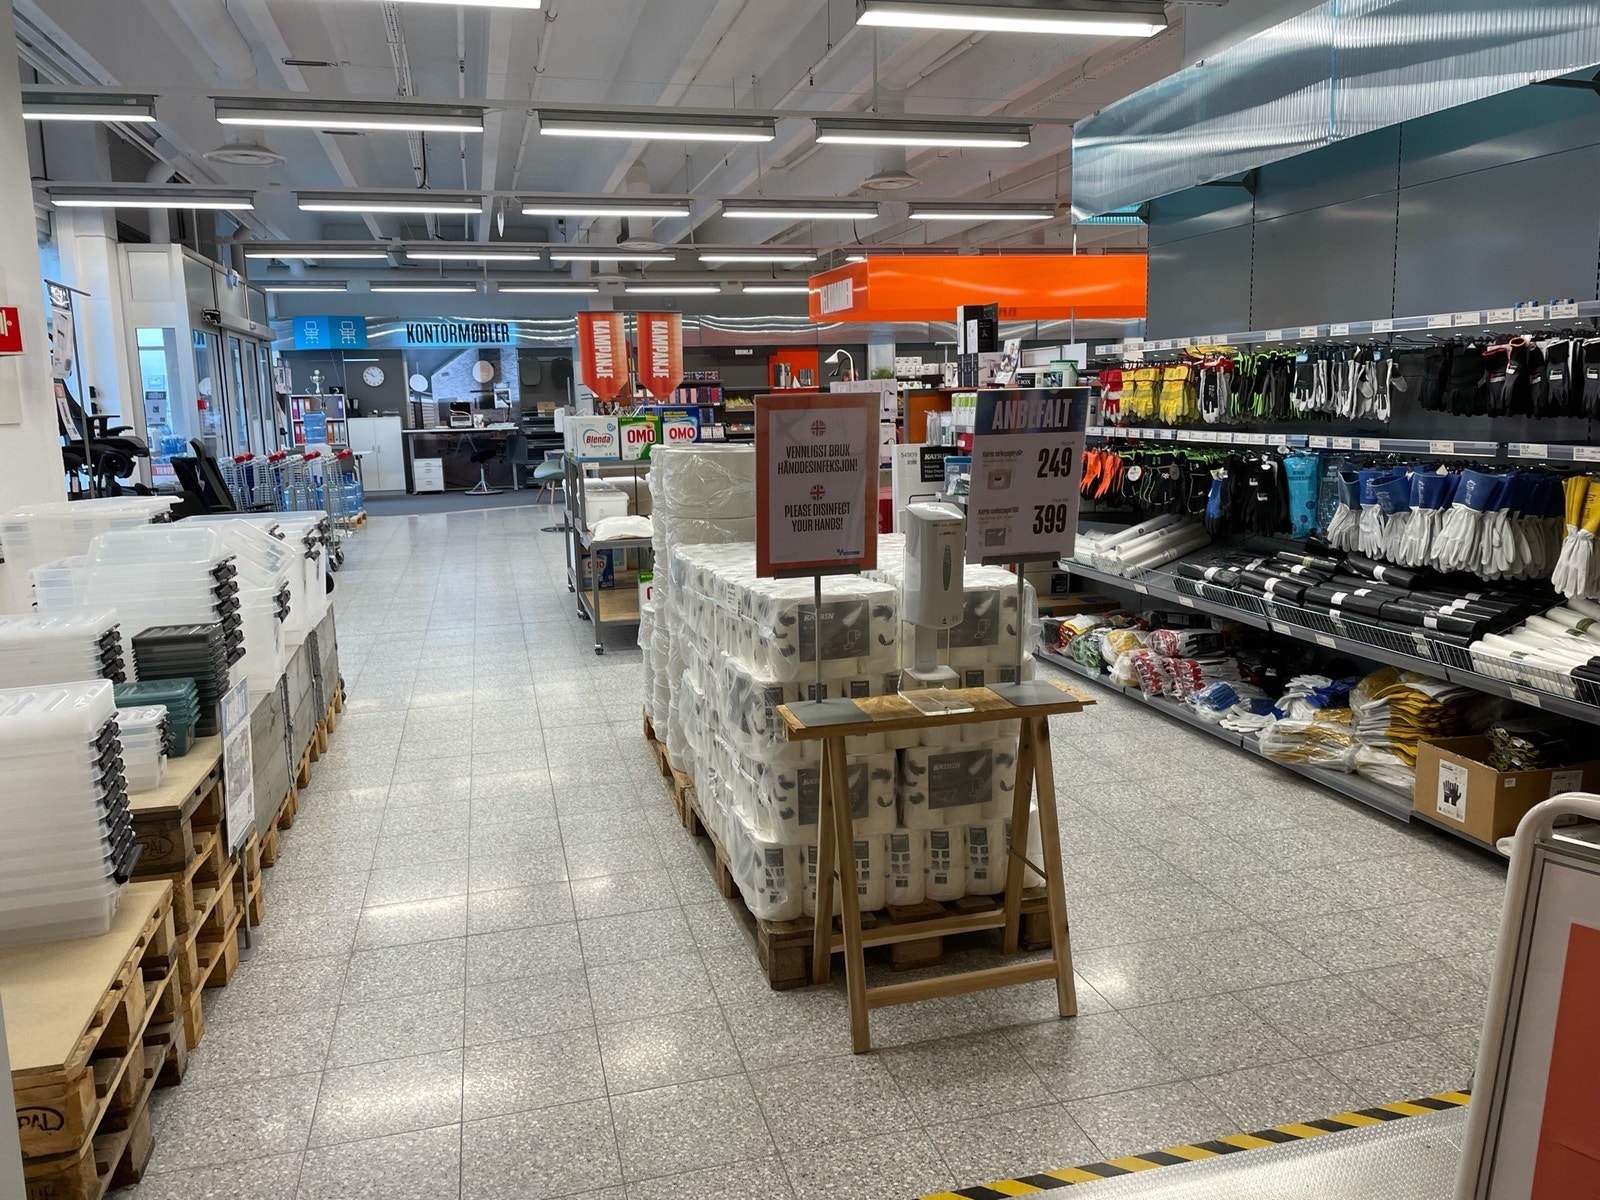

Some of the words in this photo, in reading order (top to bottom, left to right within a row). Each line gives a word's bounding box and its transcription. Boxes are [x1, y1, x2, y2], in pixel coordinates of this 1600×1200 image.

[406, 323, 510, 343] KONTORMØBLER
[593, 320, 614, 379] KAMPANJE
[652, 320, 670, 379] KAMPANJE
[992, 399, 1073, 430] ANBEFALT
[586, 435, 611, 444] Blenda
[627, 429, 655, 443] OMO
[669, 427, 695, 440] OMO
[786, 445, 827, 459] VENNLIGST
[829, 444, 850, 457] BRUK
[778, 459, 857, 475] HÅNDDESINFEKSJON!
[1037, 447, 1073, 478] 249
[784, 503, 812, 518] PLEASE
[813, 502, 851, 516] DISINFECT
[792, 519, 813, 532] YOUR
[814, 518, 843, 532] HANDS!
[1032, 503, 1068, 535] 399
[803, 612, 835, 622] KARIN
[933, 762, 960, 772] KATRIN
[17, 1113, 56, 1131] PAL
